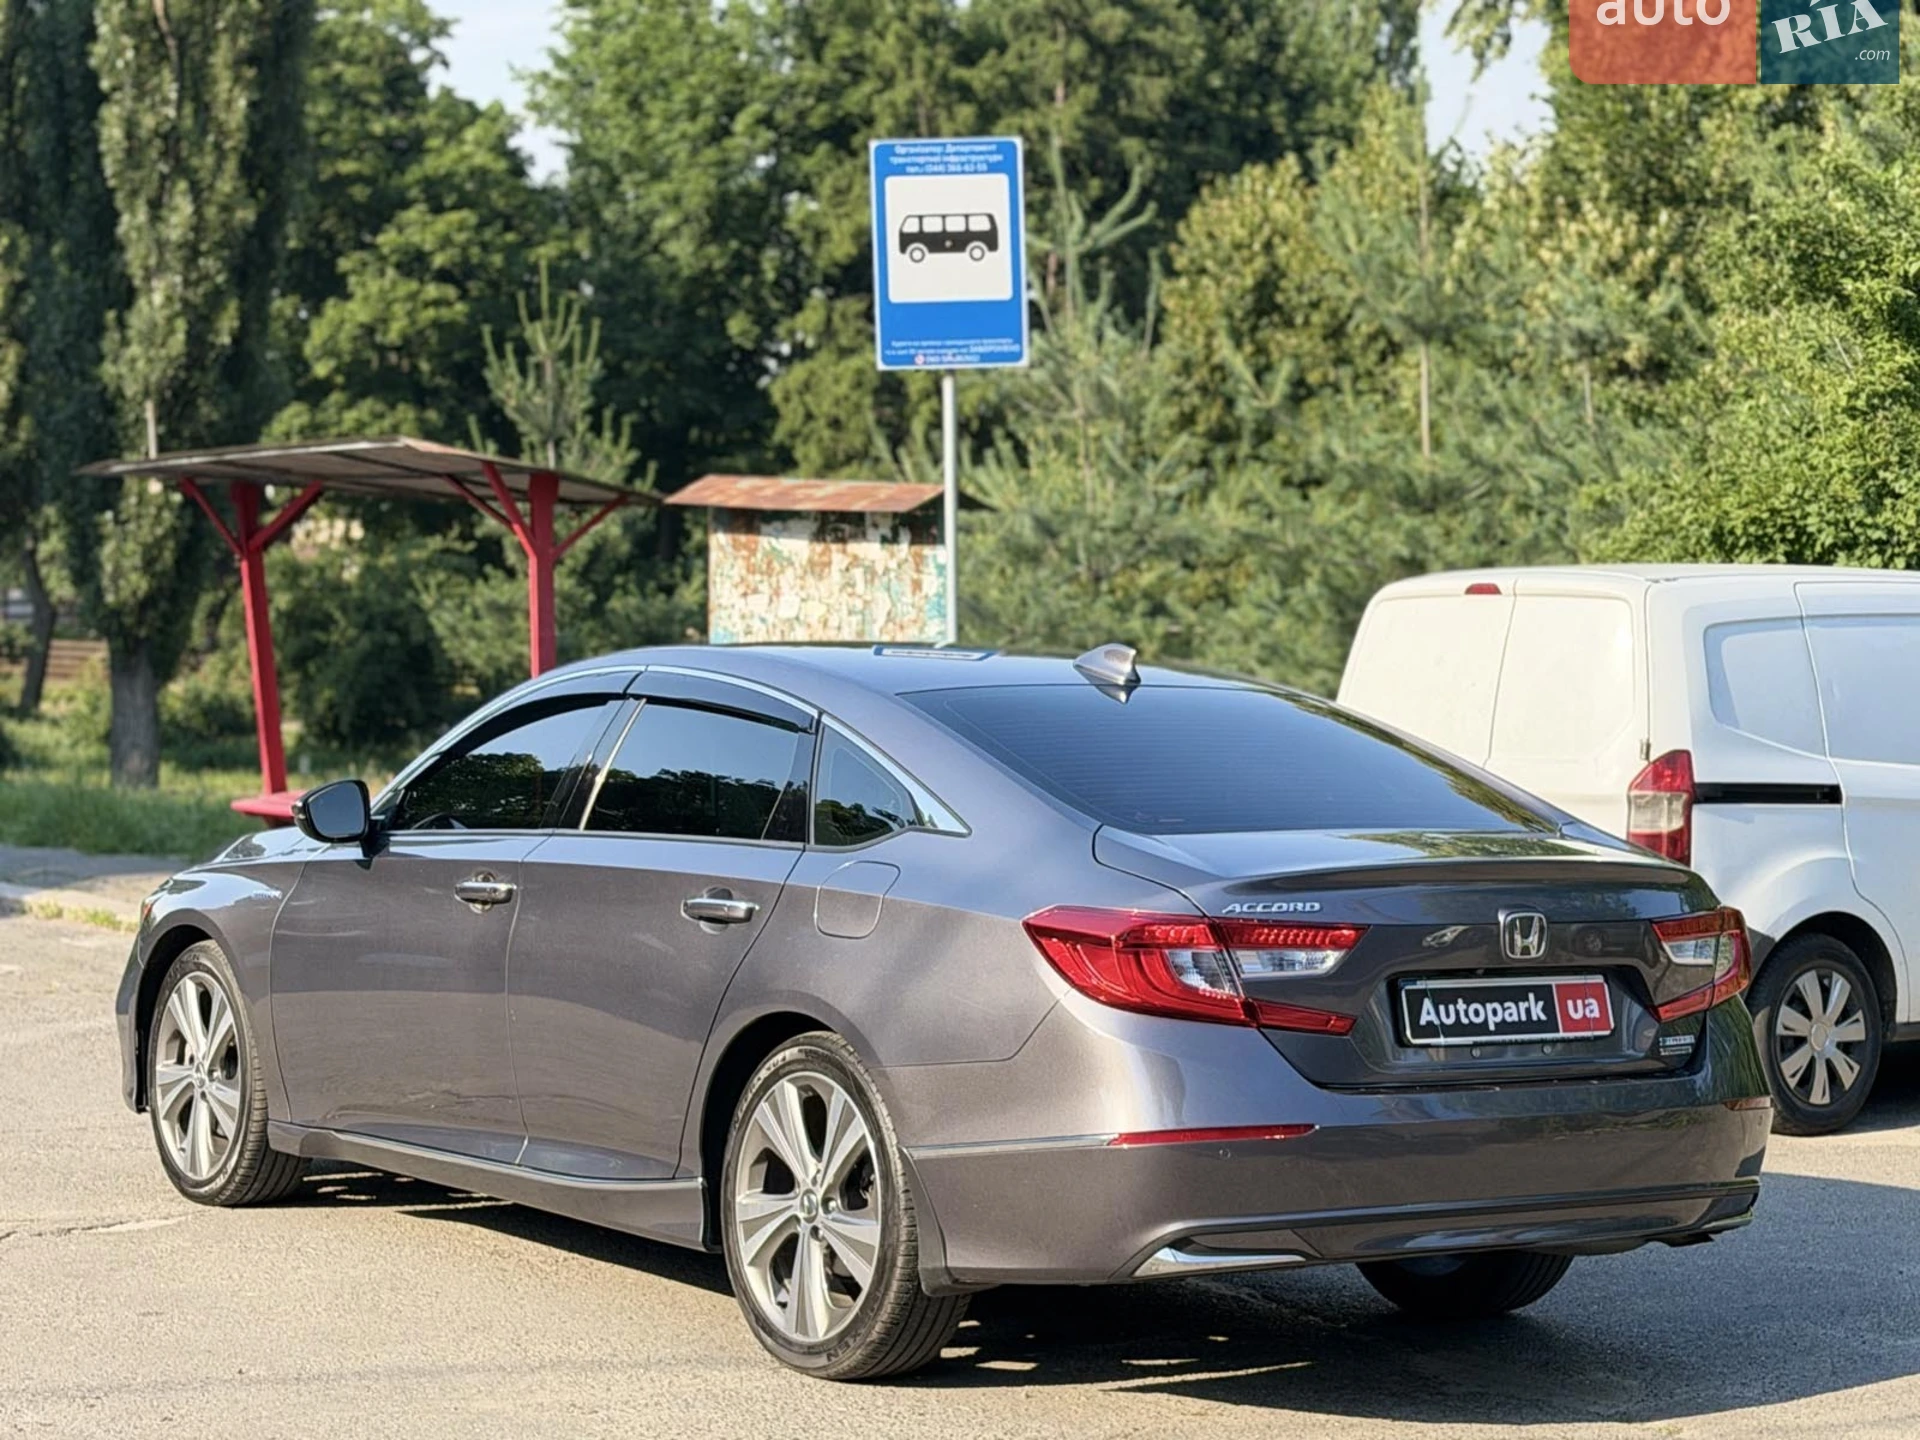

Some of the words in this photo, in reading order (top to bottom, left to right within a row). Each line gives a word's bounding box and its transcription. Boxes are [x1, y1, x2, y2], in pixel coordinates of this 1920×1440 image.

[1221, 901, 1321, 914] ACCORD
[1419, 992, 1547, 1031] Autopark
[1566, 997, 1601, 1020] ua
